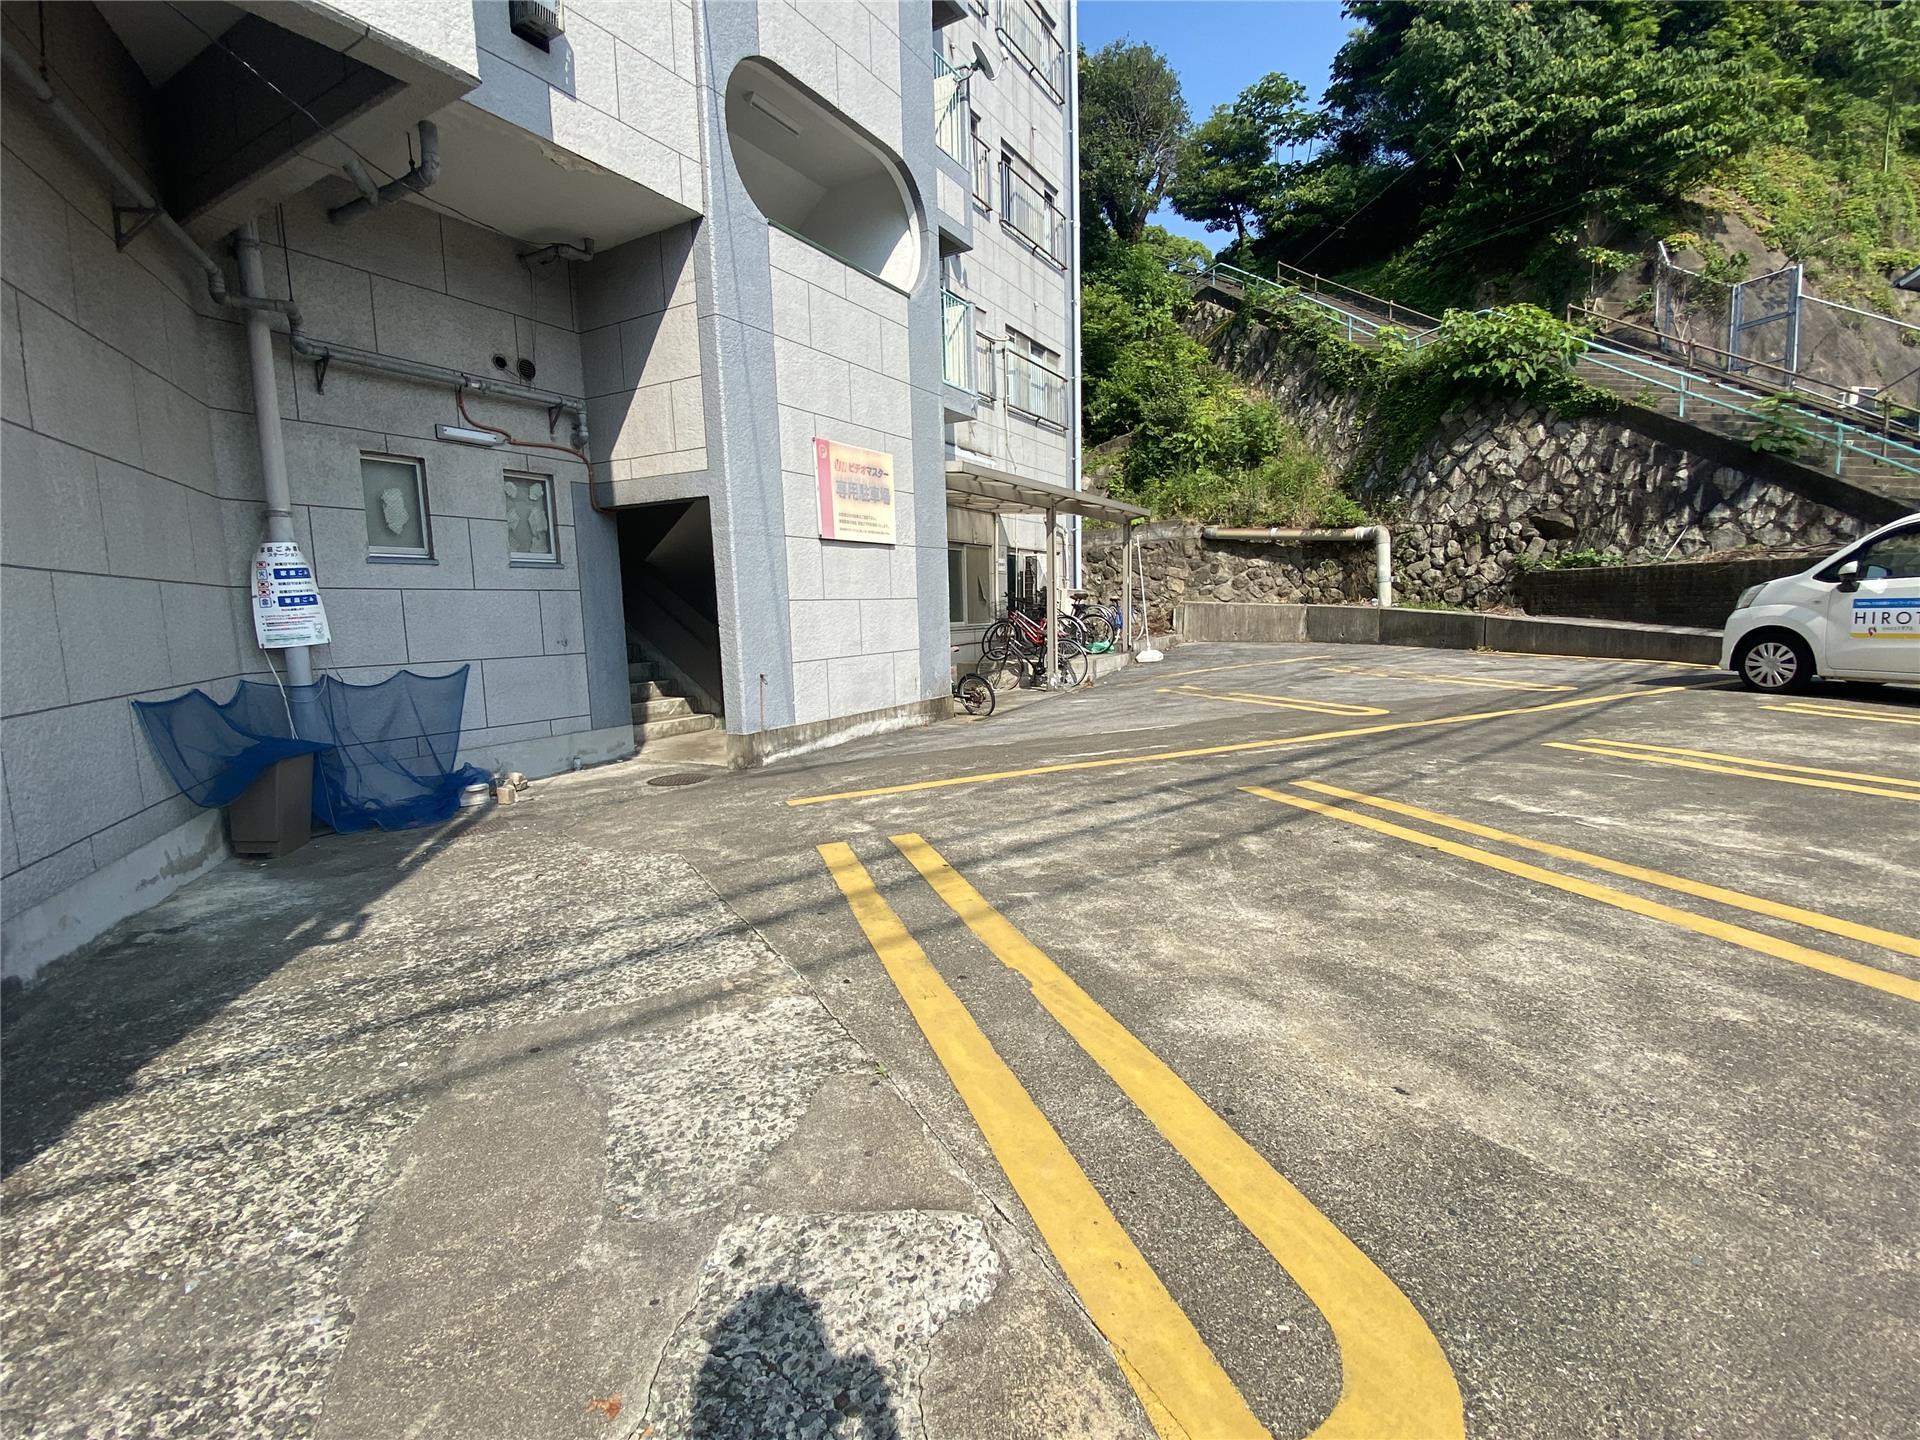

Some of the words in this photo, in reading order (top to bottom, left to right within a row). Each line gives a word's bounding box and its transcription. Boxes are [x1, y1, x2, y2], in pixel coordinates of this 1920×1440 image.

[848, 462, 889, 478] ビデオマスター
[836, 480, 890, 505] 専用駐車場
